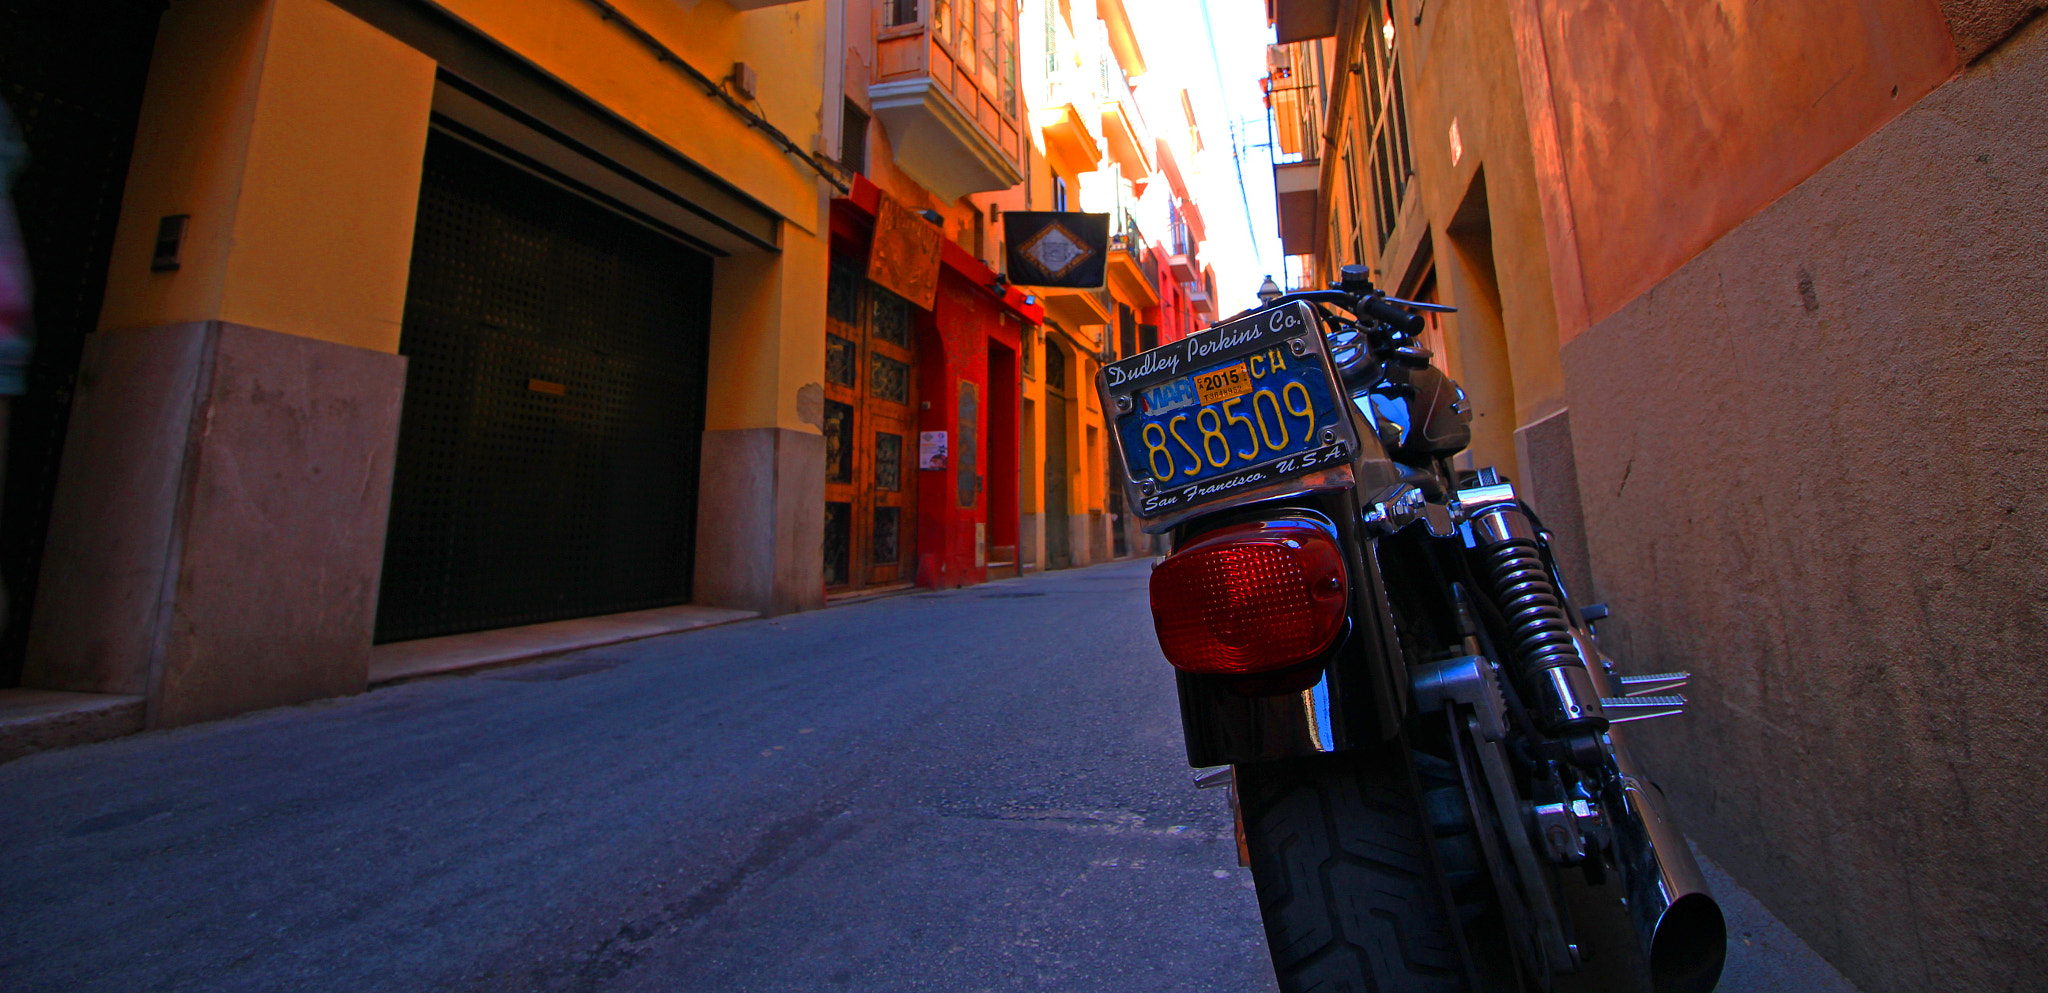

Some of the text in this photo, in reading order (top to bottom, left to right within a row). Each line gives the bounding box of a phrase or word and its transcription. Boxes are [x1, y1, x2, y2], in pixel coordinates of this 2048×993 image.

[1109, 310, 1301, 387] Dudley Perkins Co.
[1204, 369, 1240, 391] 2015
[1250, 351, 1287, 379] CA
[1141, 379, 1193, 410] MAR
[1144, 495, 1178, 511] San
[1276, 446, 1346, 474] U.S.A.
